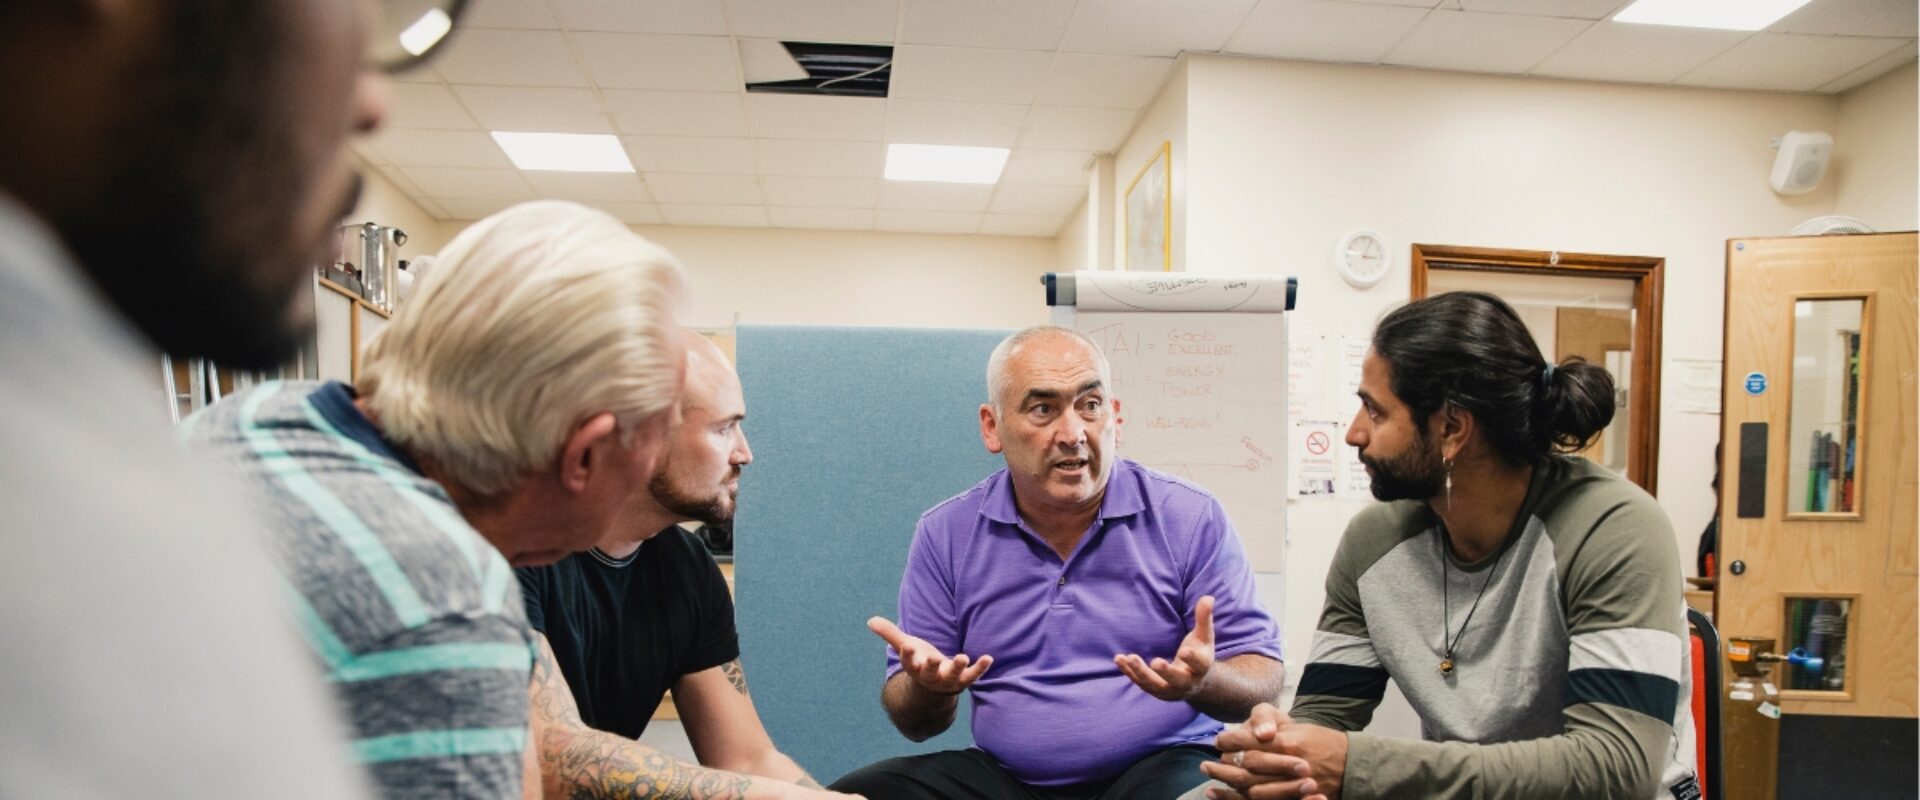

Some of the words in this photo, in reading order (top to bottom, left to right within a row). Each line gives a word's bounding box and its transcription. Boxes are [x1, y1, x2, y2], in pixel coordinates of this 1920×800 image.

[1167, 328, 1216, 342] GOOD
[1167, 343, 1234, 356] EXCELLENT
[1165, 365, 1226, 379] ENERGY
